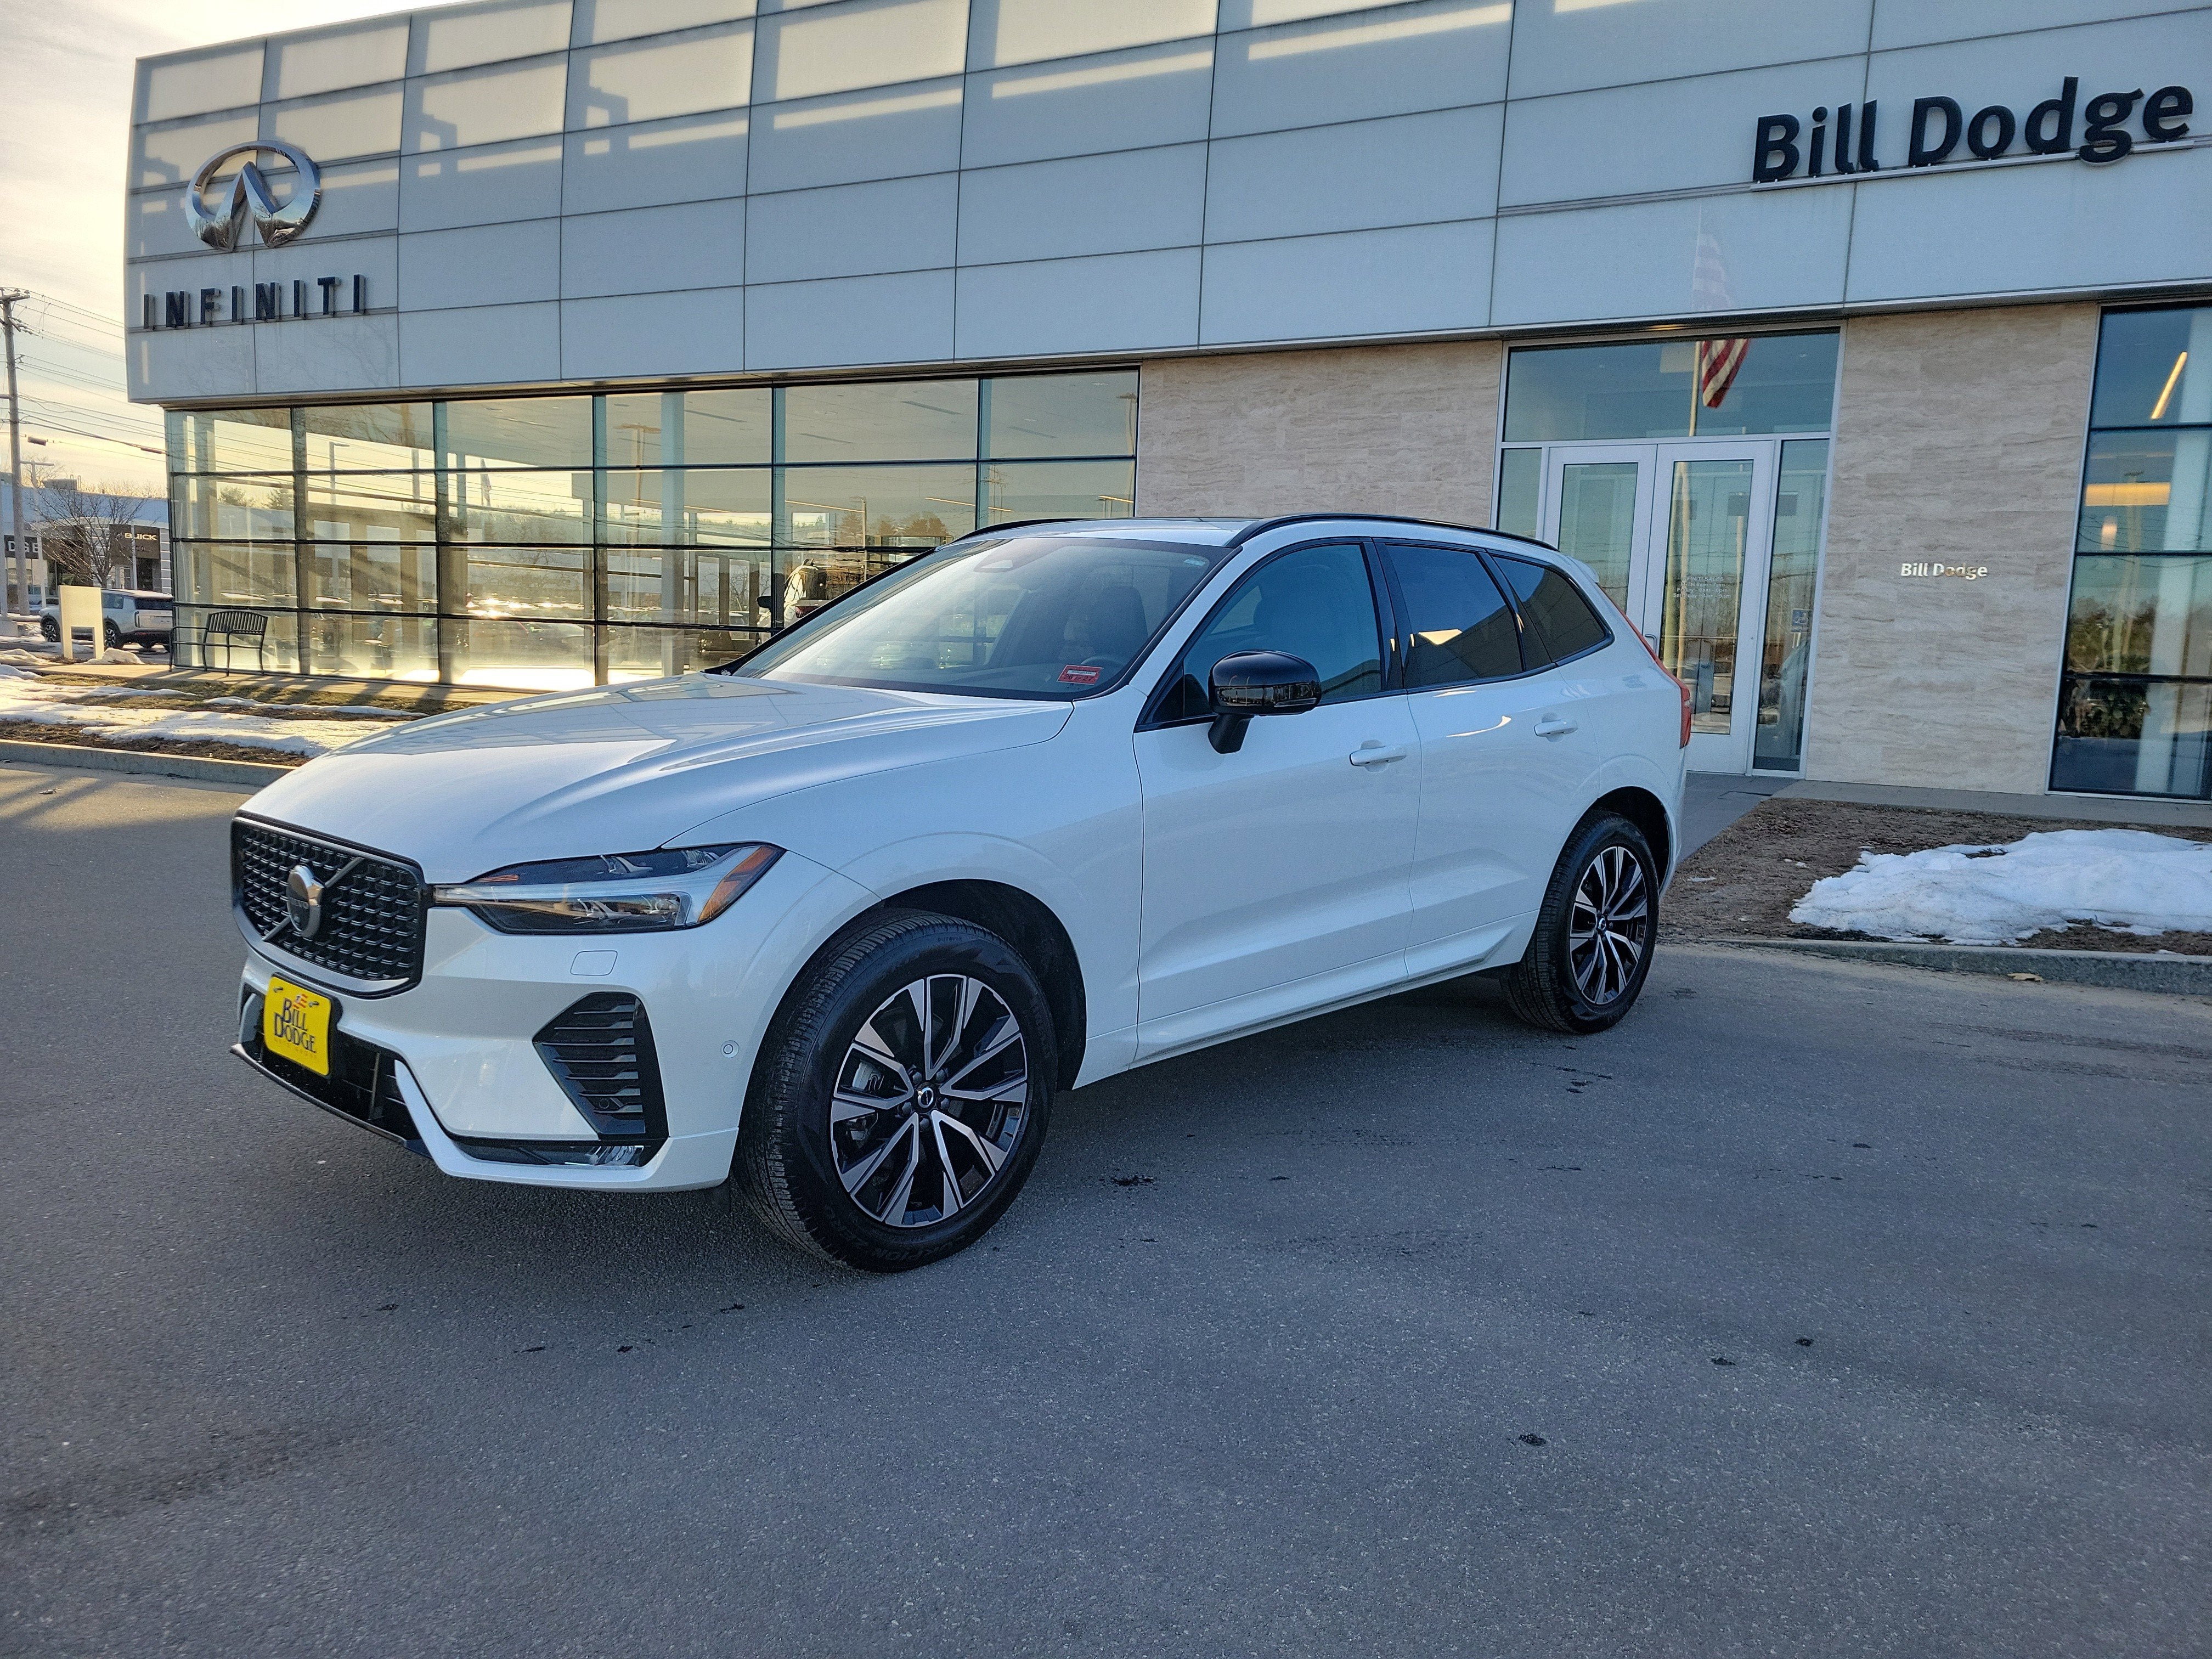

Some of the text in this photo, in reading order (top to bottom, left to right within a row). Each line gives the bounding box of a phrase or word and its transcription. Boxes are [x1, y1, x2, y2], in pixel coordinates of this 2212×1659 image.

[1753, 76, 2193, 182] Bill Dodge
[144, 274, 364, 329] INFINITI
[124, 532, 158, 541] BUICK
[1900, 562, 1988, 580] Bill Dodge
[273, 1012, 317, 1053] DODGE
[283, 998, 307, 1031] BILL
